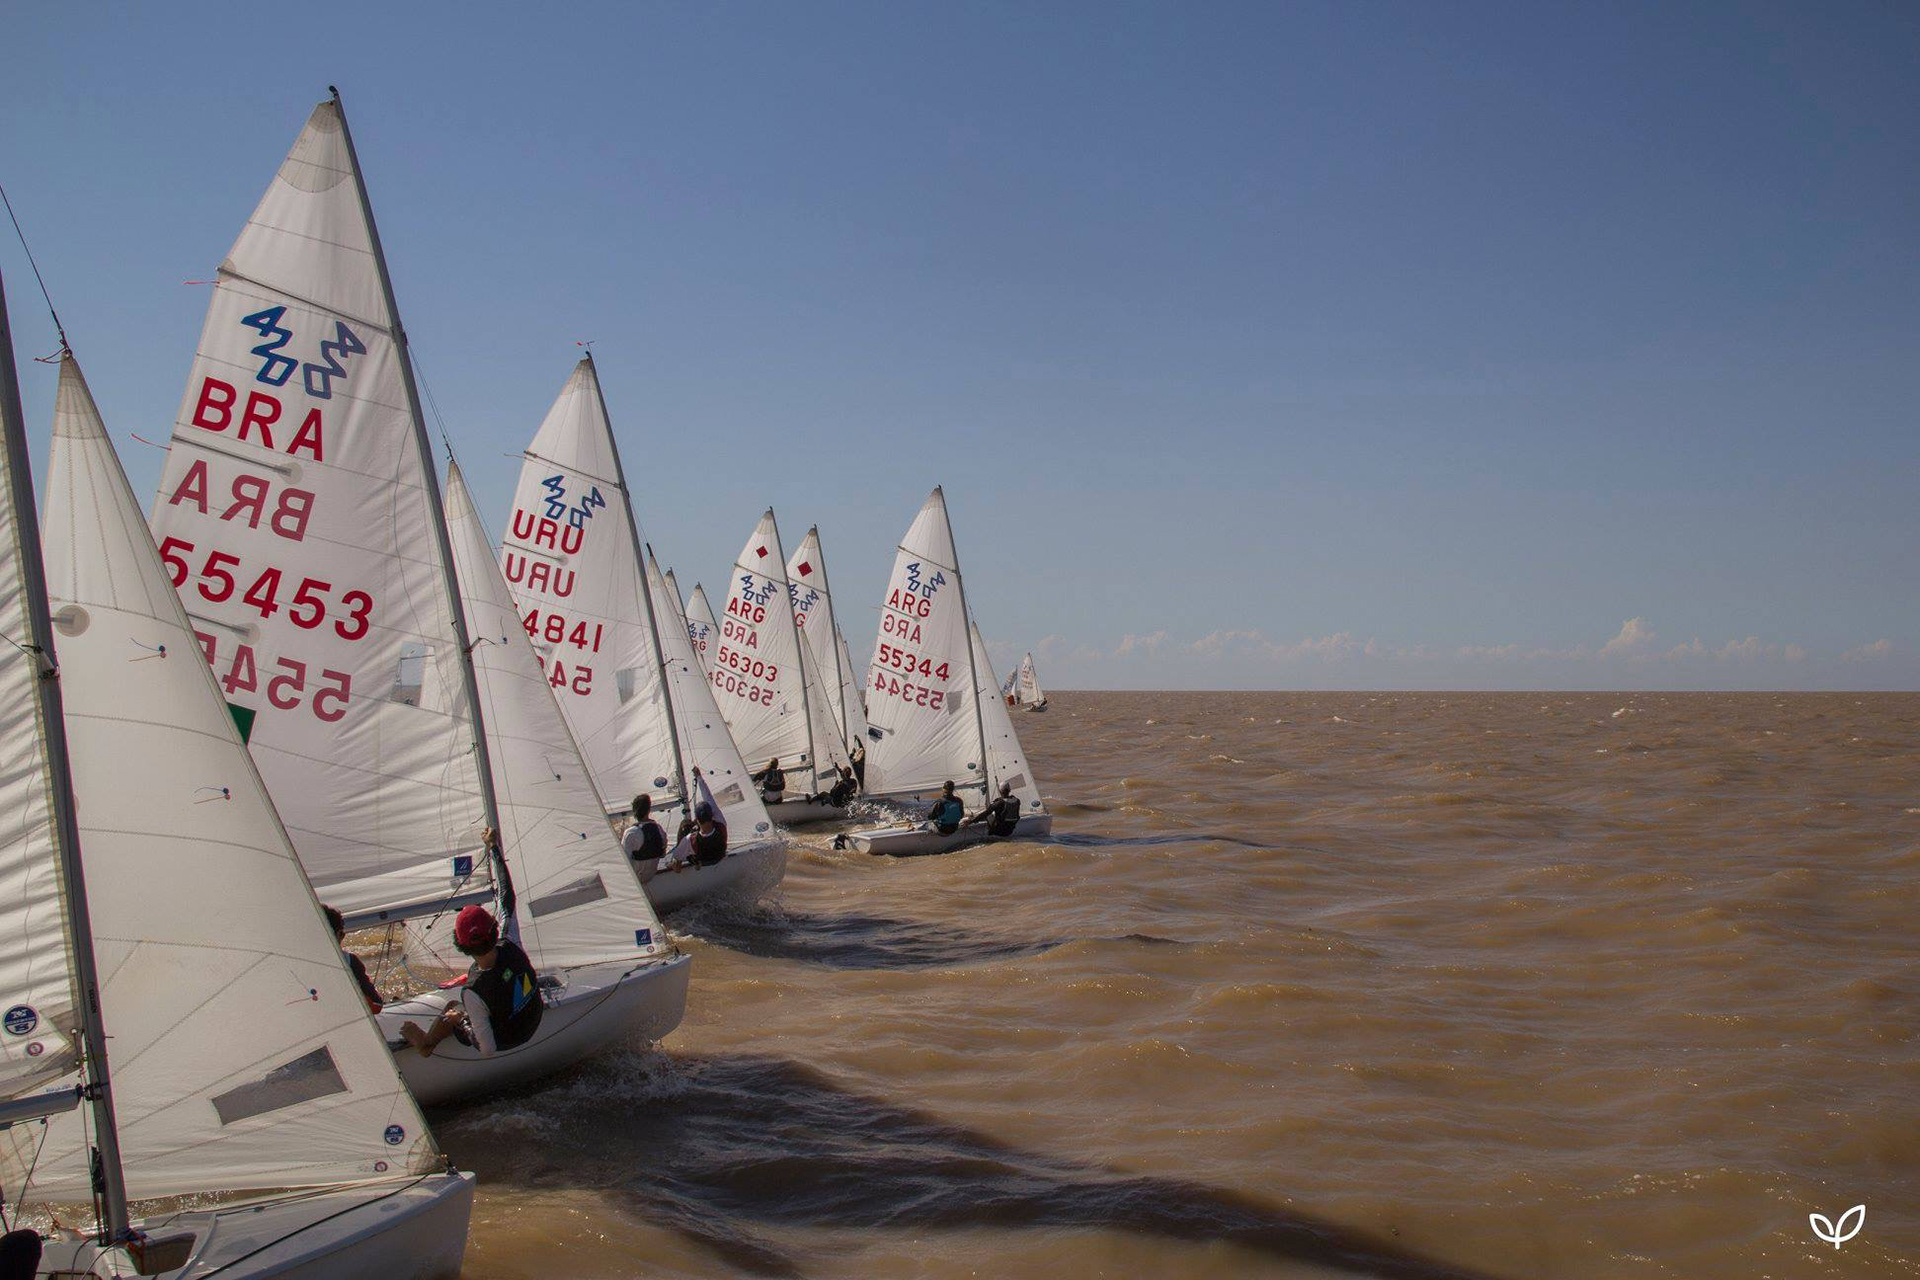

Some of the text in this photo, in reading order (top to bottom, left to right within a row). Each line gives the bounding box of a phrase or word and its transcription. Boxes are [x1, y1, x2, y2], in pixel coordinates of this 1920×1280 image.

[240, 306, 298, 387] 420
[191, 376, 323, 462] BRA
[541, 475, 567, 520] 420
[513, 509, 585, 555] URU
[158, 536, 373, 641] 55453
[727, 597, 766, 624] ARG
[889, 588, 931, 618] ARG
[514, 603, 602, 653] 4841
[718, 646, 777, 682] 56303
[879, 644, 949, 682] 55344
